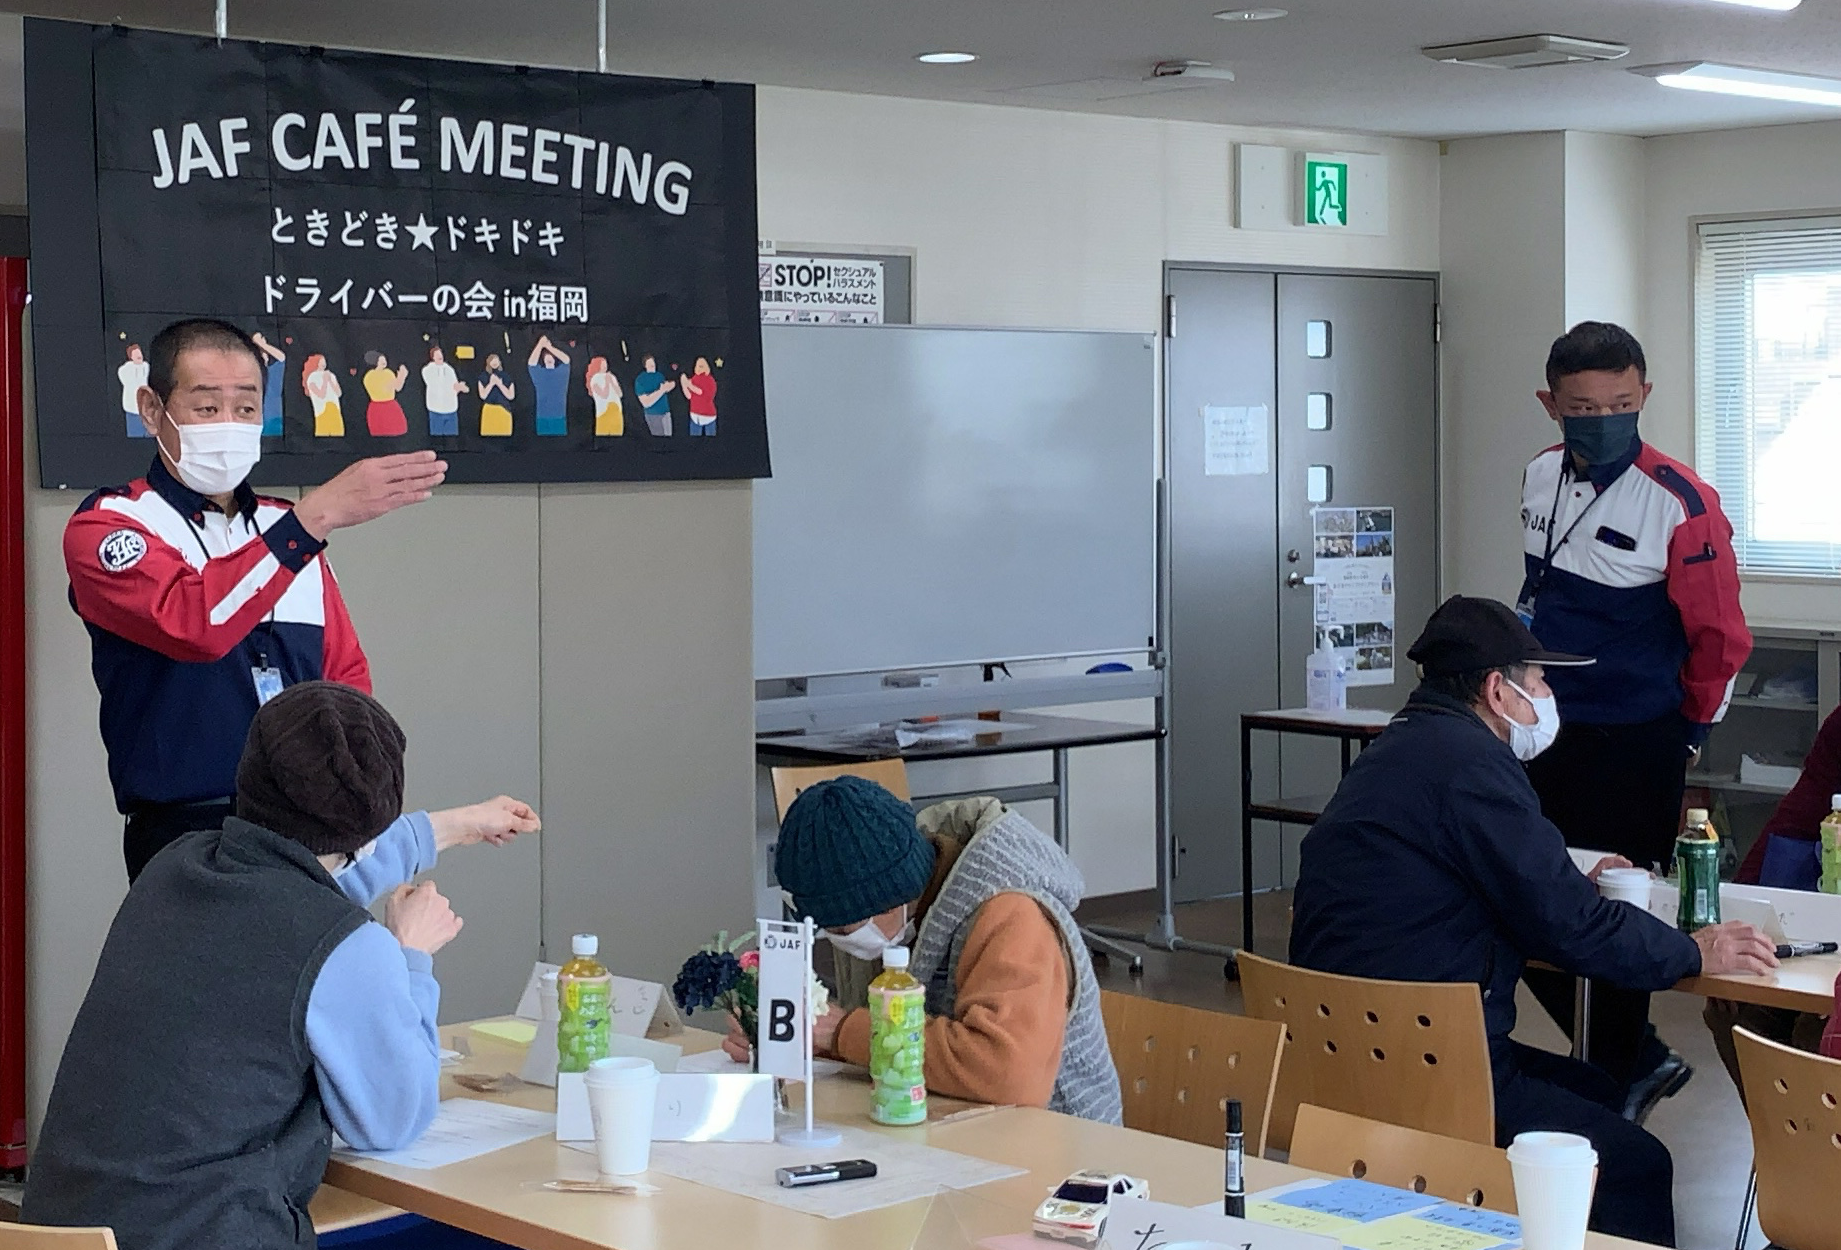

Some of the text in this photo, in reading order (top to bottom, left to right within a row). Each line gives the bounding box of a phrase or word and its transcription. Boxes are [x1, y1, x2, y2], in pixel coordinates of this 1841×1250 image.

[153, 98, 693, 216] JAF CAFÉ MEETING
[774, 264, 831, 288] STOP!
[833, 266, 877, 278] セクシュアル
[832, 278, 877, 289] ハラスメント
[779, 938, 802, 950] JAF
[768, 998, 796, 1042] B
